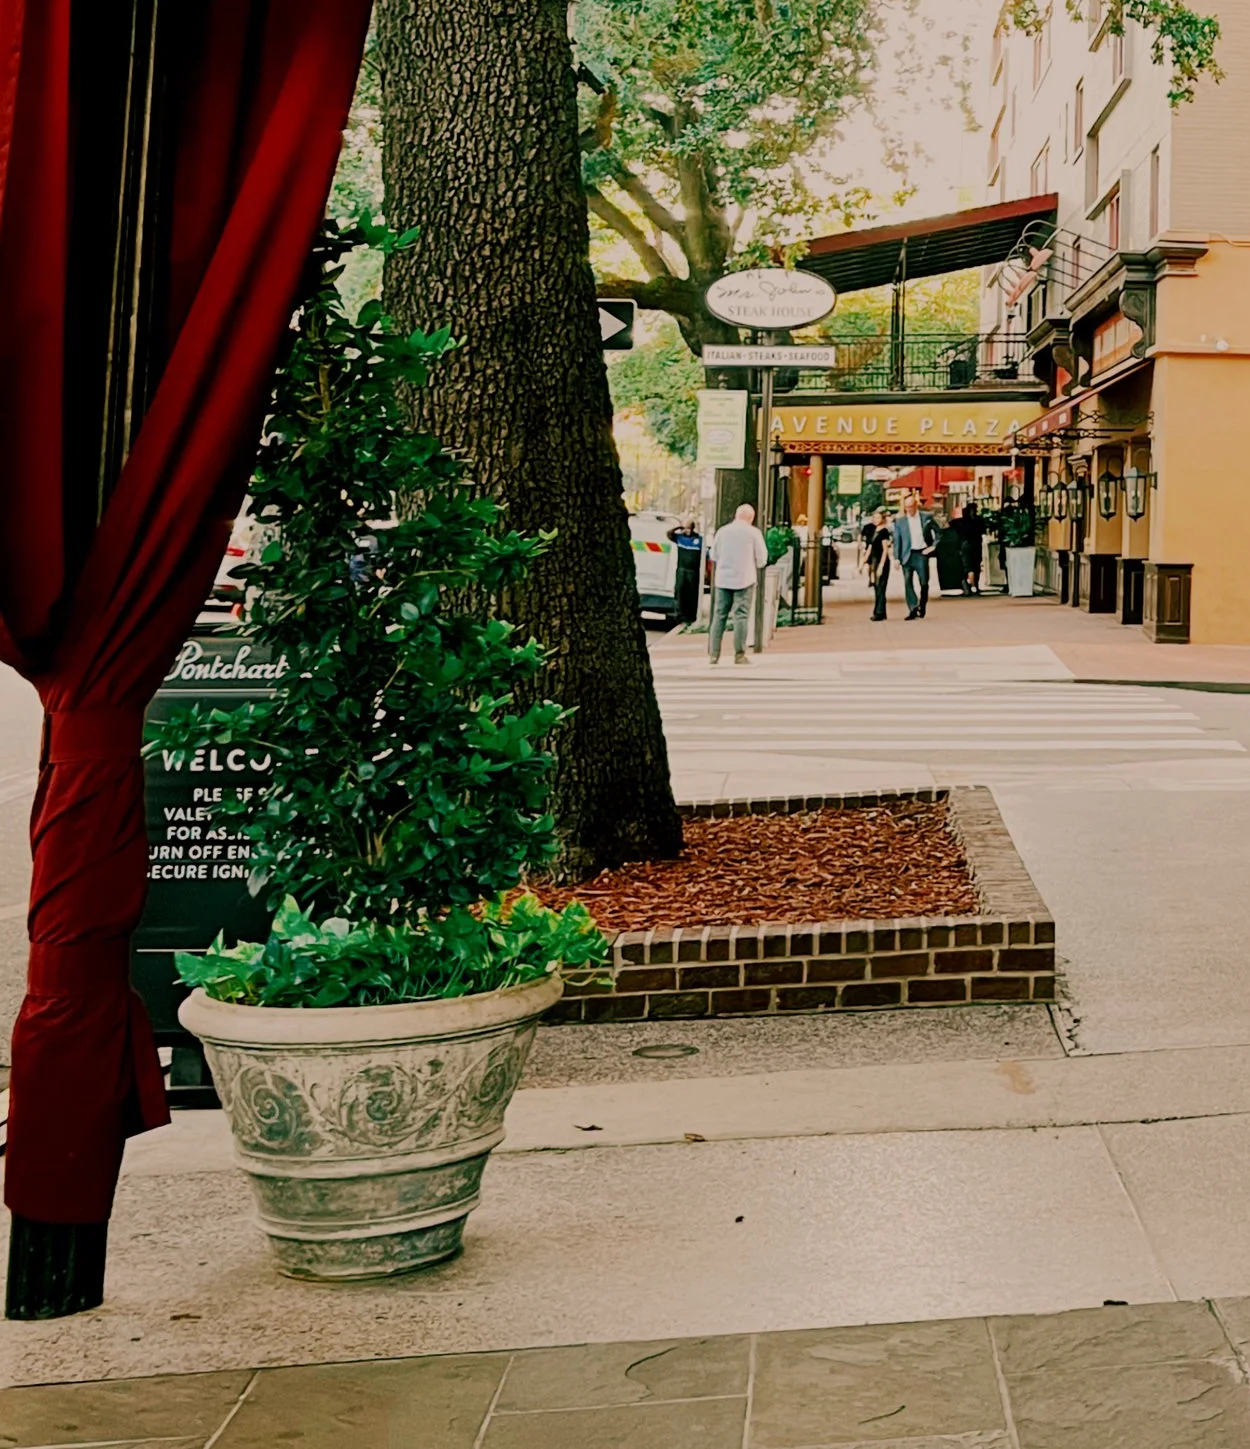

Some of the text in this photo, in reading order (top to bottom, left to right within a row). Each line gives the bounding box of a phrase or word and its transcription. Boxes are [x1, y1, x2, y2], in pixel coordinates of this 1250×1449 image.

[728, 306, 815, 317] STEAK HOUSE
[706, 350, 830, 361] ITALIAN STEAKS SEAFOOD
[770, 415, 1022, 437] AVENUE PLAZA
[164, 640, 290, 681] Pontchart
[167, 826, 202, 840] FOR
[188, 845, 223, 859] OFF
[147, 864, 208, 879] ECURE
